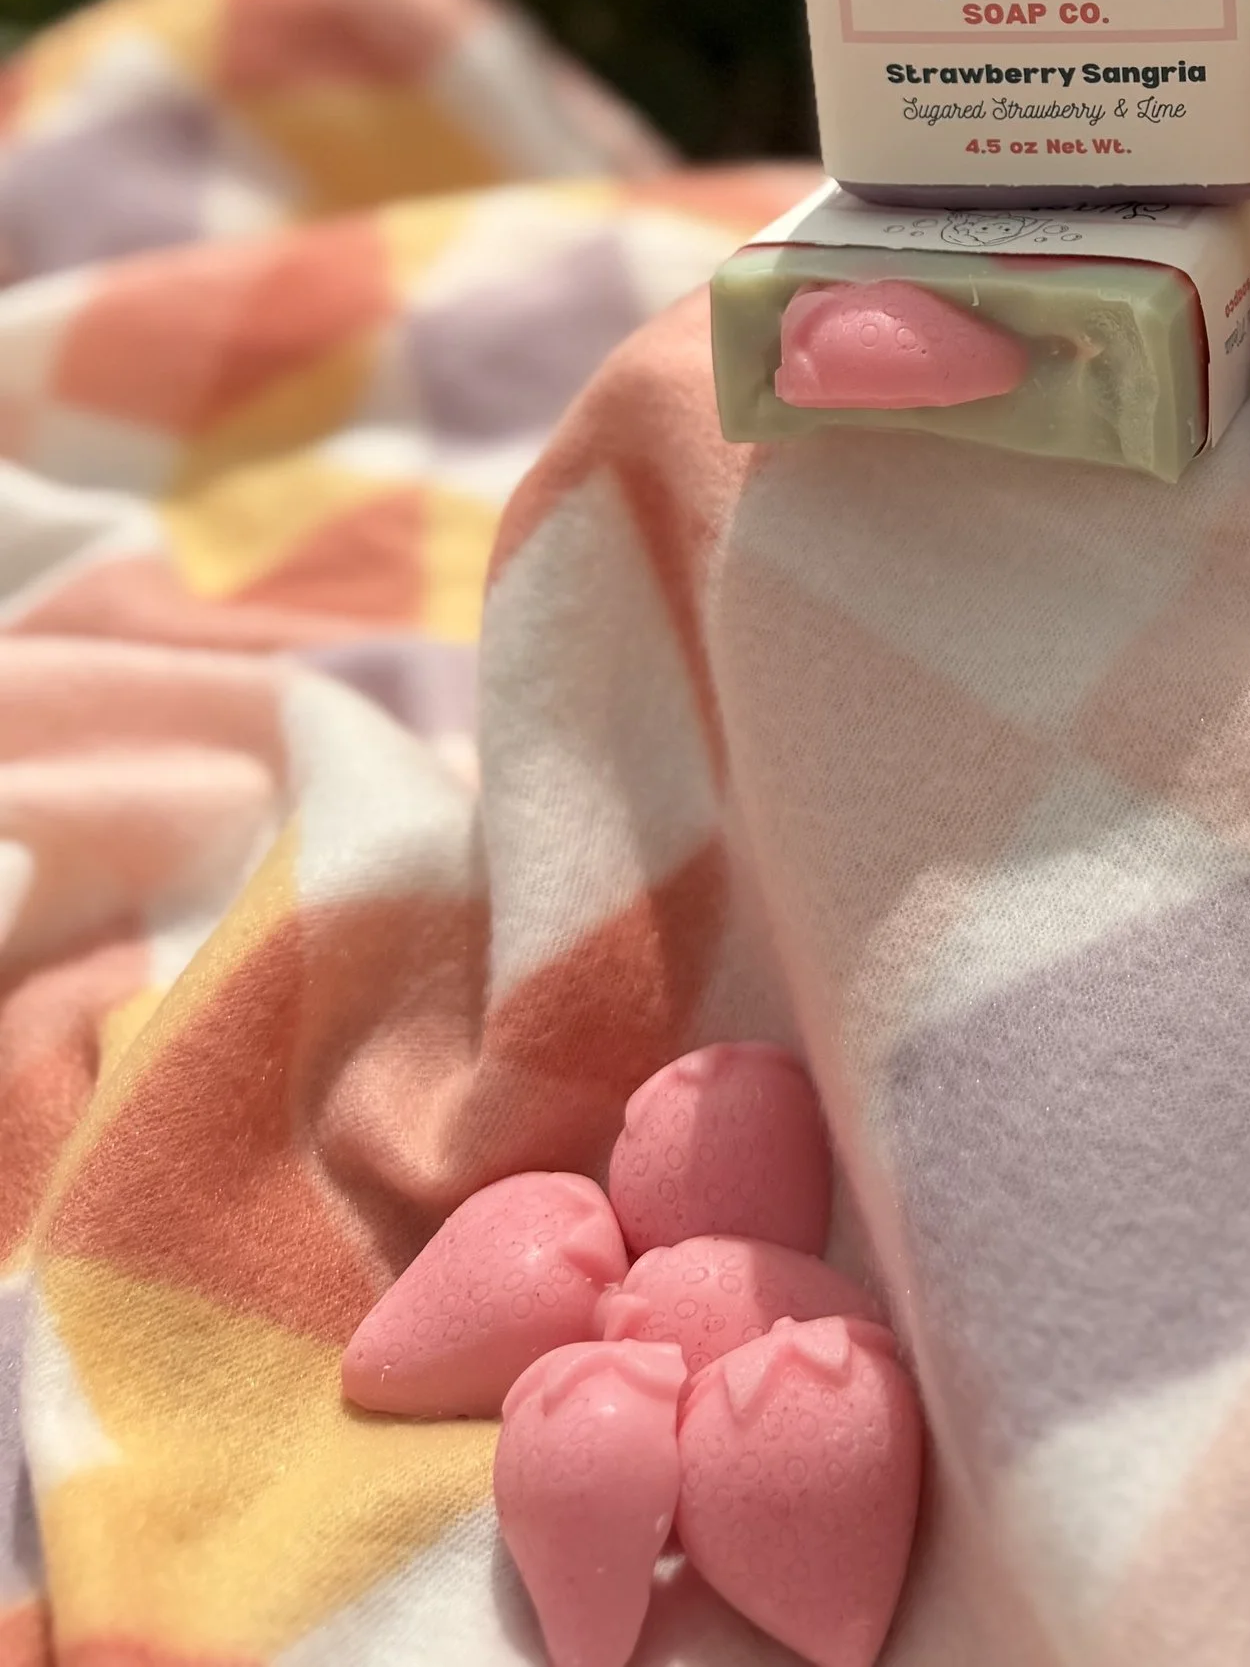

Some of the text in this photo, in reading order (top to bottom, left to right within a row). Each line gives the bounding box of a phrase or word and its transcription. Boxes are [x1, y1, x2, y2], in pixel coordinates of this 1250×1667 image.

[962, 3, 1110, 24] SOAP CO.
[886, 61, 1207, 89] Strawberry Sangria
[903, 96, 1187, 127] Sugared Strawberry & Lime
[965, 138, 1132, 154] 4.5 oz Net Wt.
